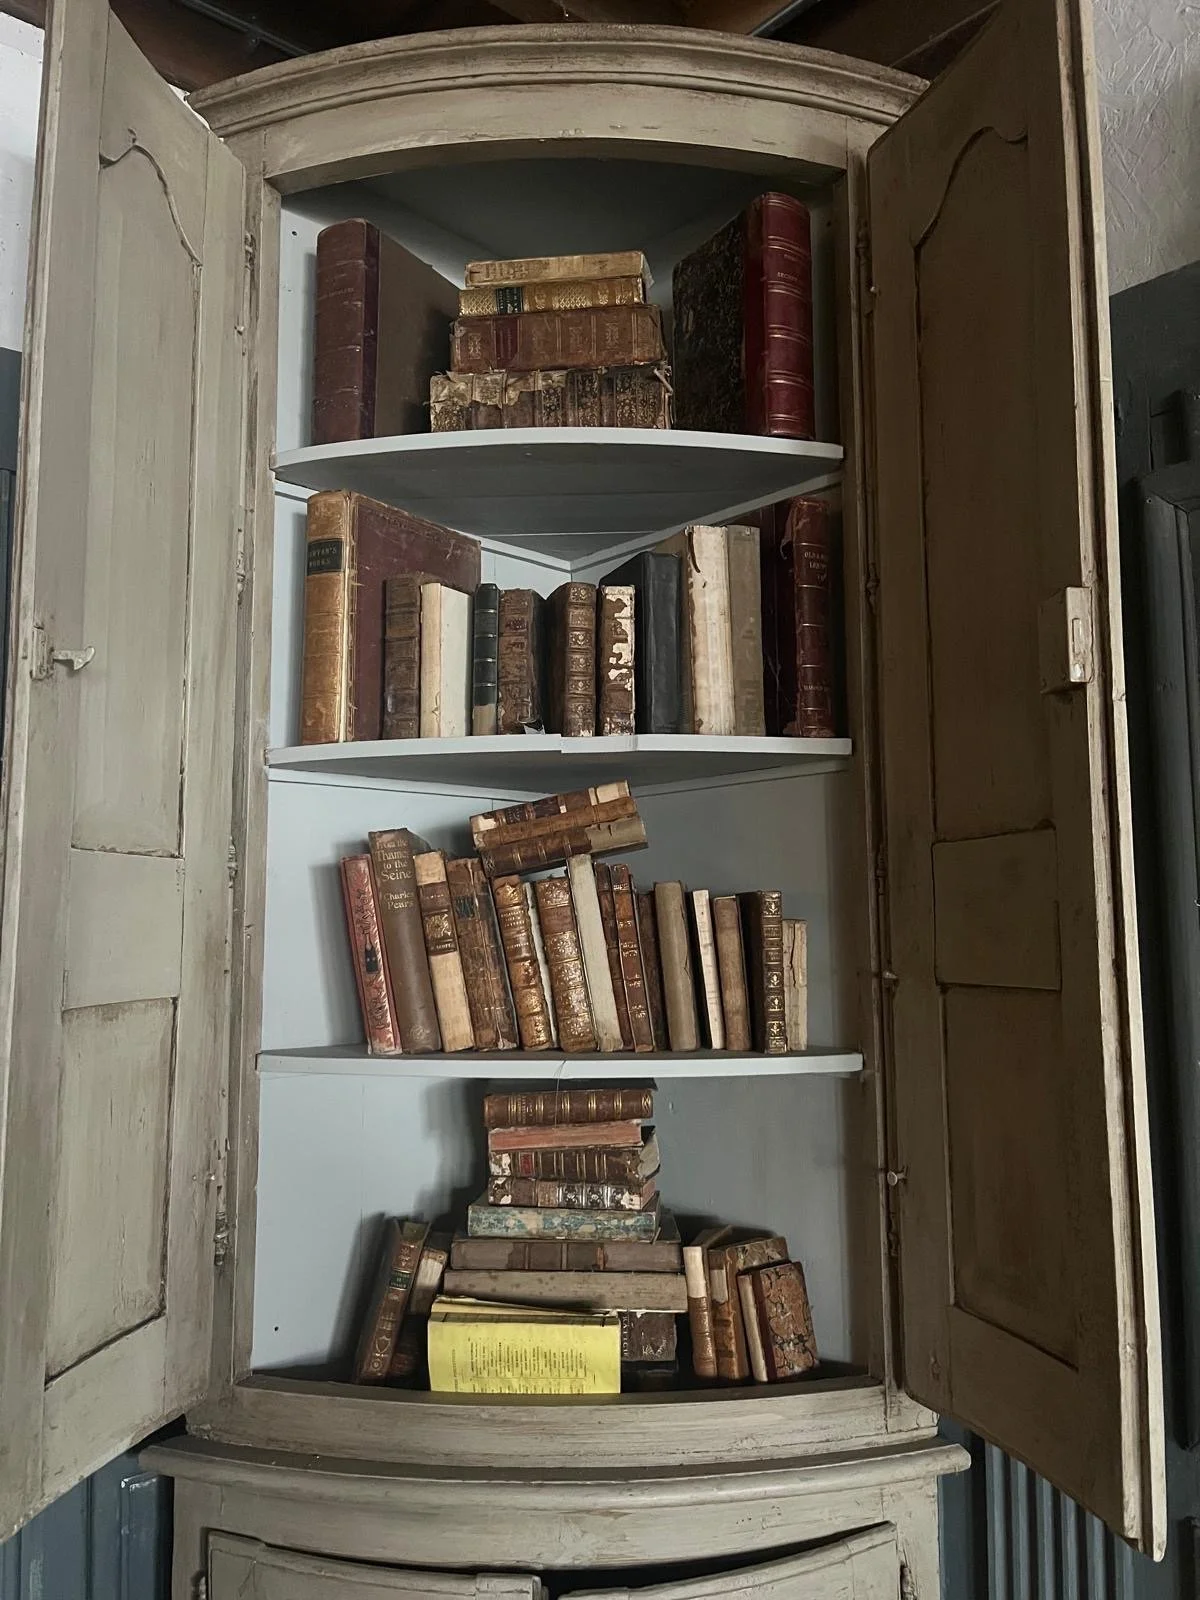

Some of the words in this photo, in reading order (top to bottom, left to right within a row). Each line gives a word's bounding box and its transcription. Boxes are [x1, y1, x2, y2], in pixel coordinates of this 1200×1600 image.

[383, 862, 392, 870] to
[394, 859, 408, 869] the
[381, 869, 413, 880] Seine
[384, 890, 415, 901] Charles
[387, 901, 414, 910] Pears
